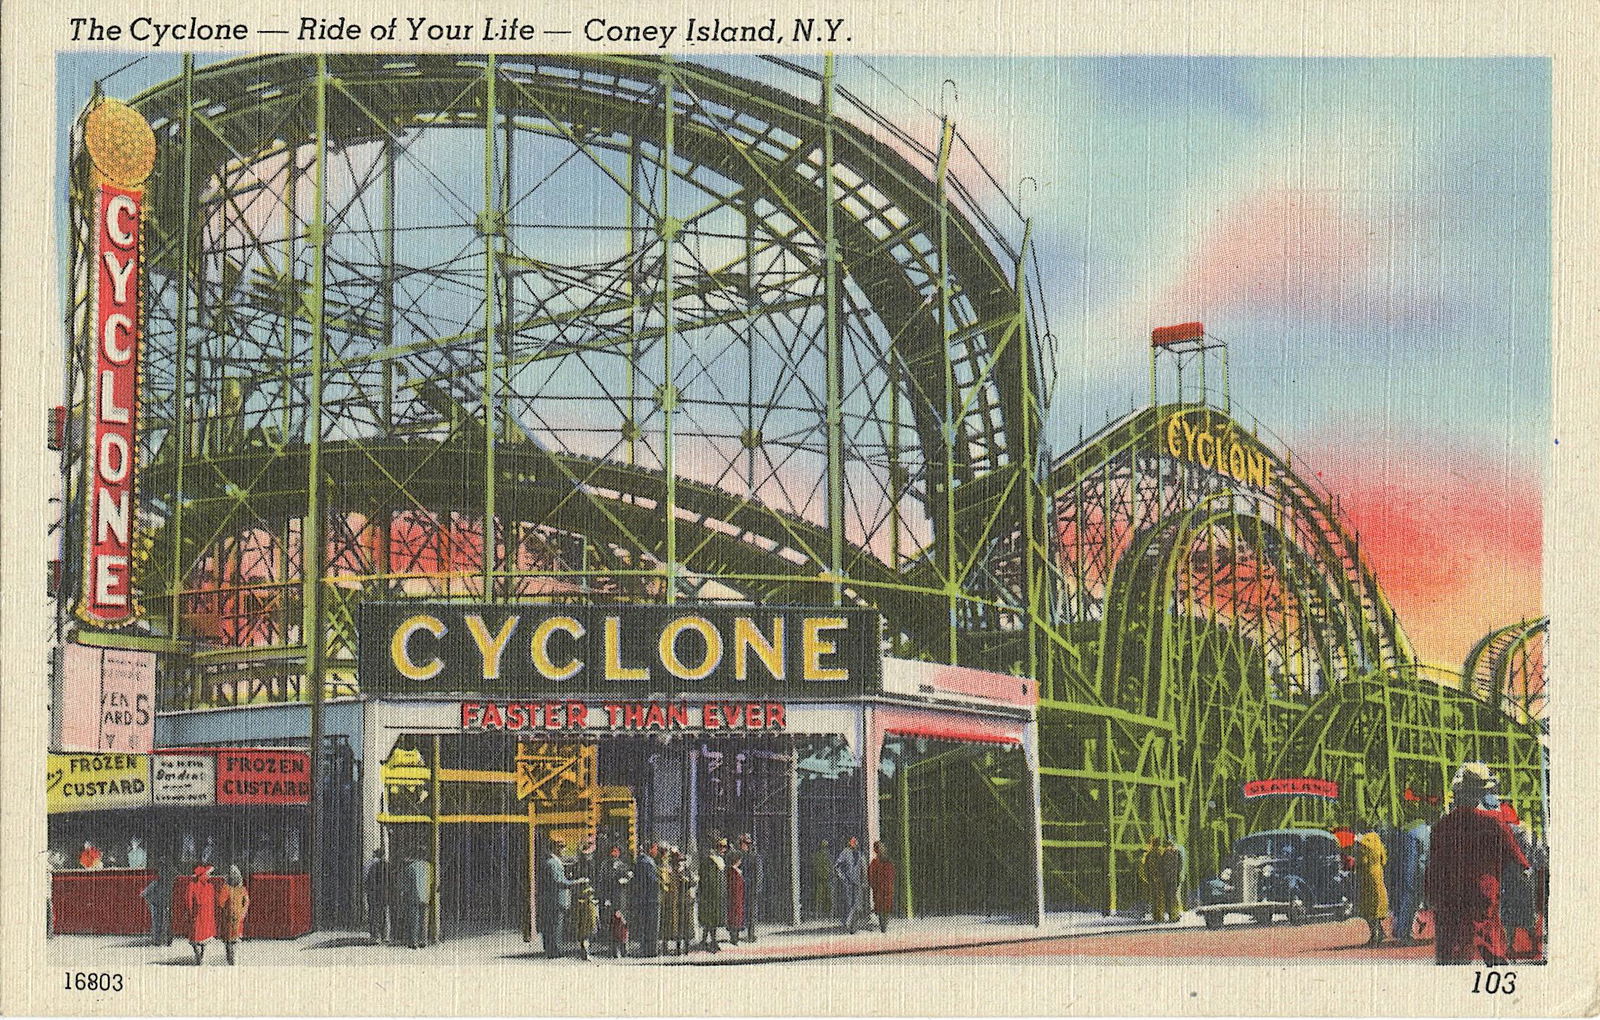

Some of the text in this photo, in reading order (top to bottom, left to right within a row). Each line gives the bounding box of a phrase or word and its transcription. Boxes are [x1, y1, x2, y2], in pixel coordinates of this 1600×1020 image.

[96, 194, 137, 609] CYCLONE
[390, 613, 850, 683] CYCLONE
[460, 702, 787, 730] FASTER THAN EVER
[70, 755, 137, 774] FROZEN
[226, 756, 304, 774] FROZEN
[62, 778, 146, 798] CUSTARD
[222, 779, 310, 797] CUSTARD
